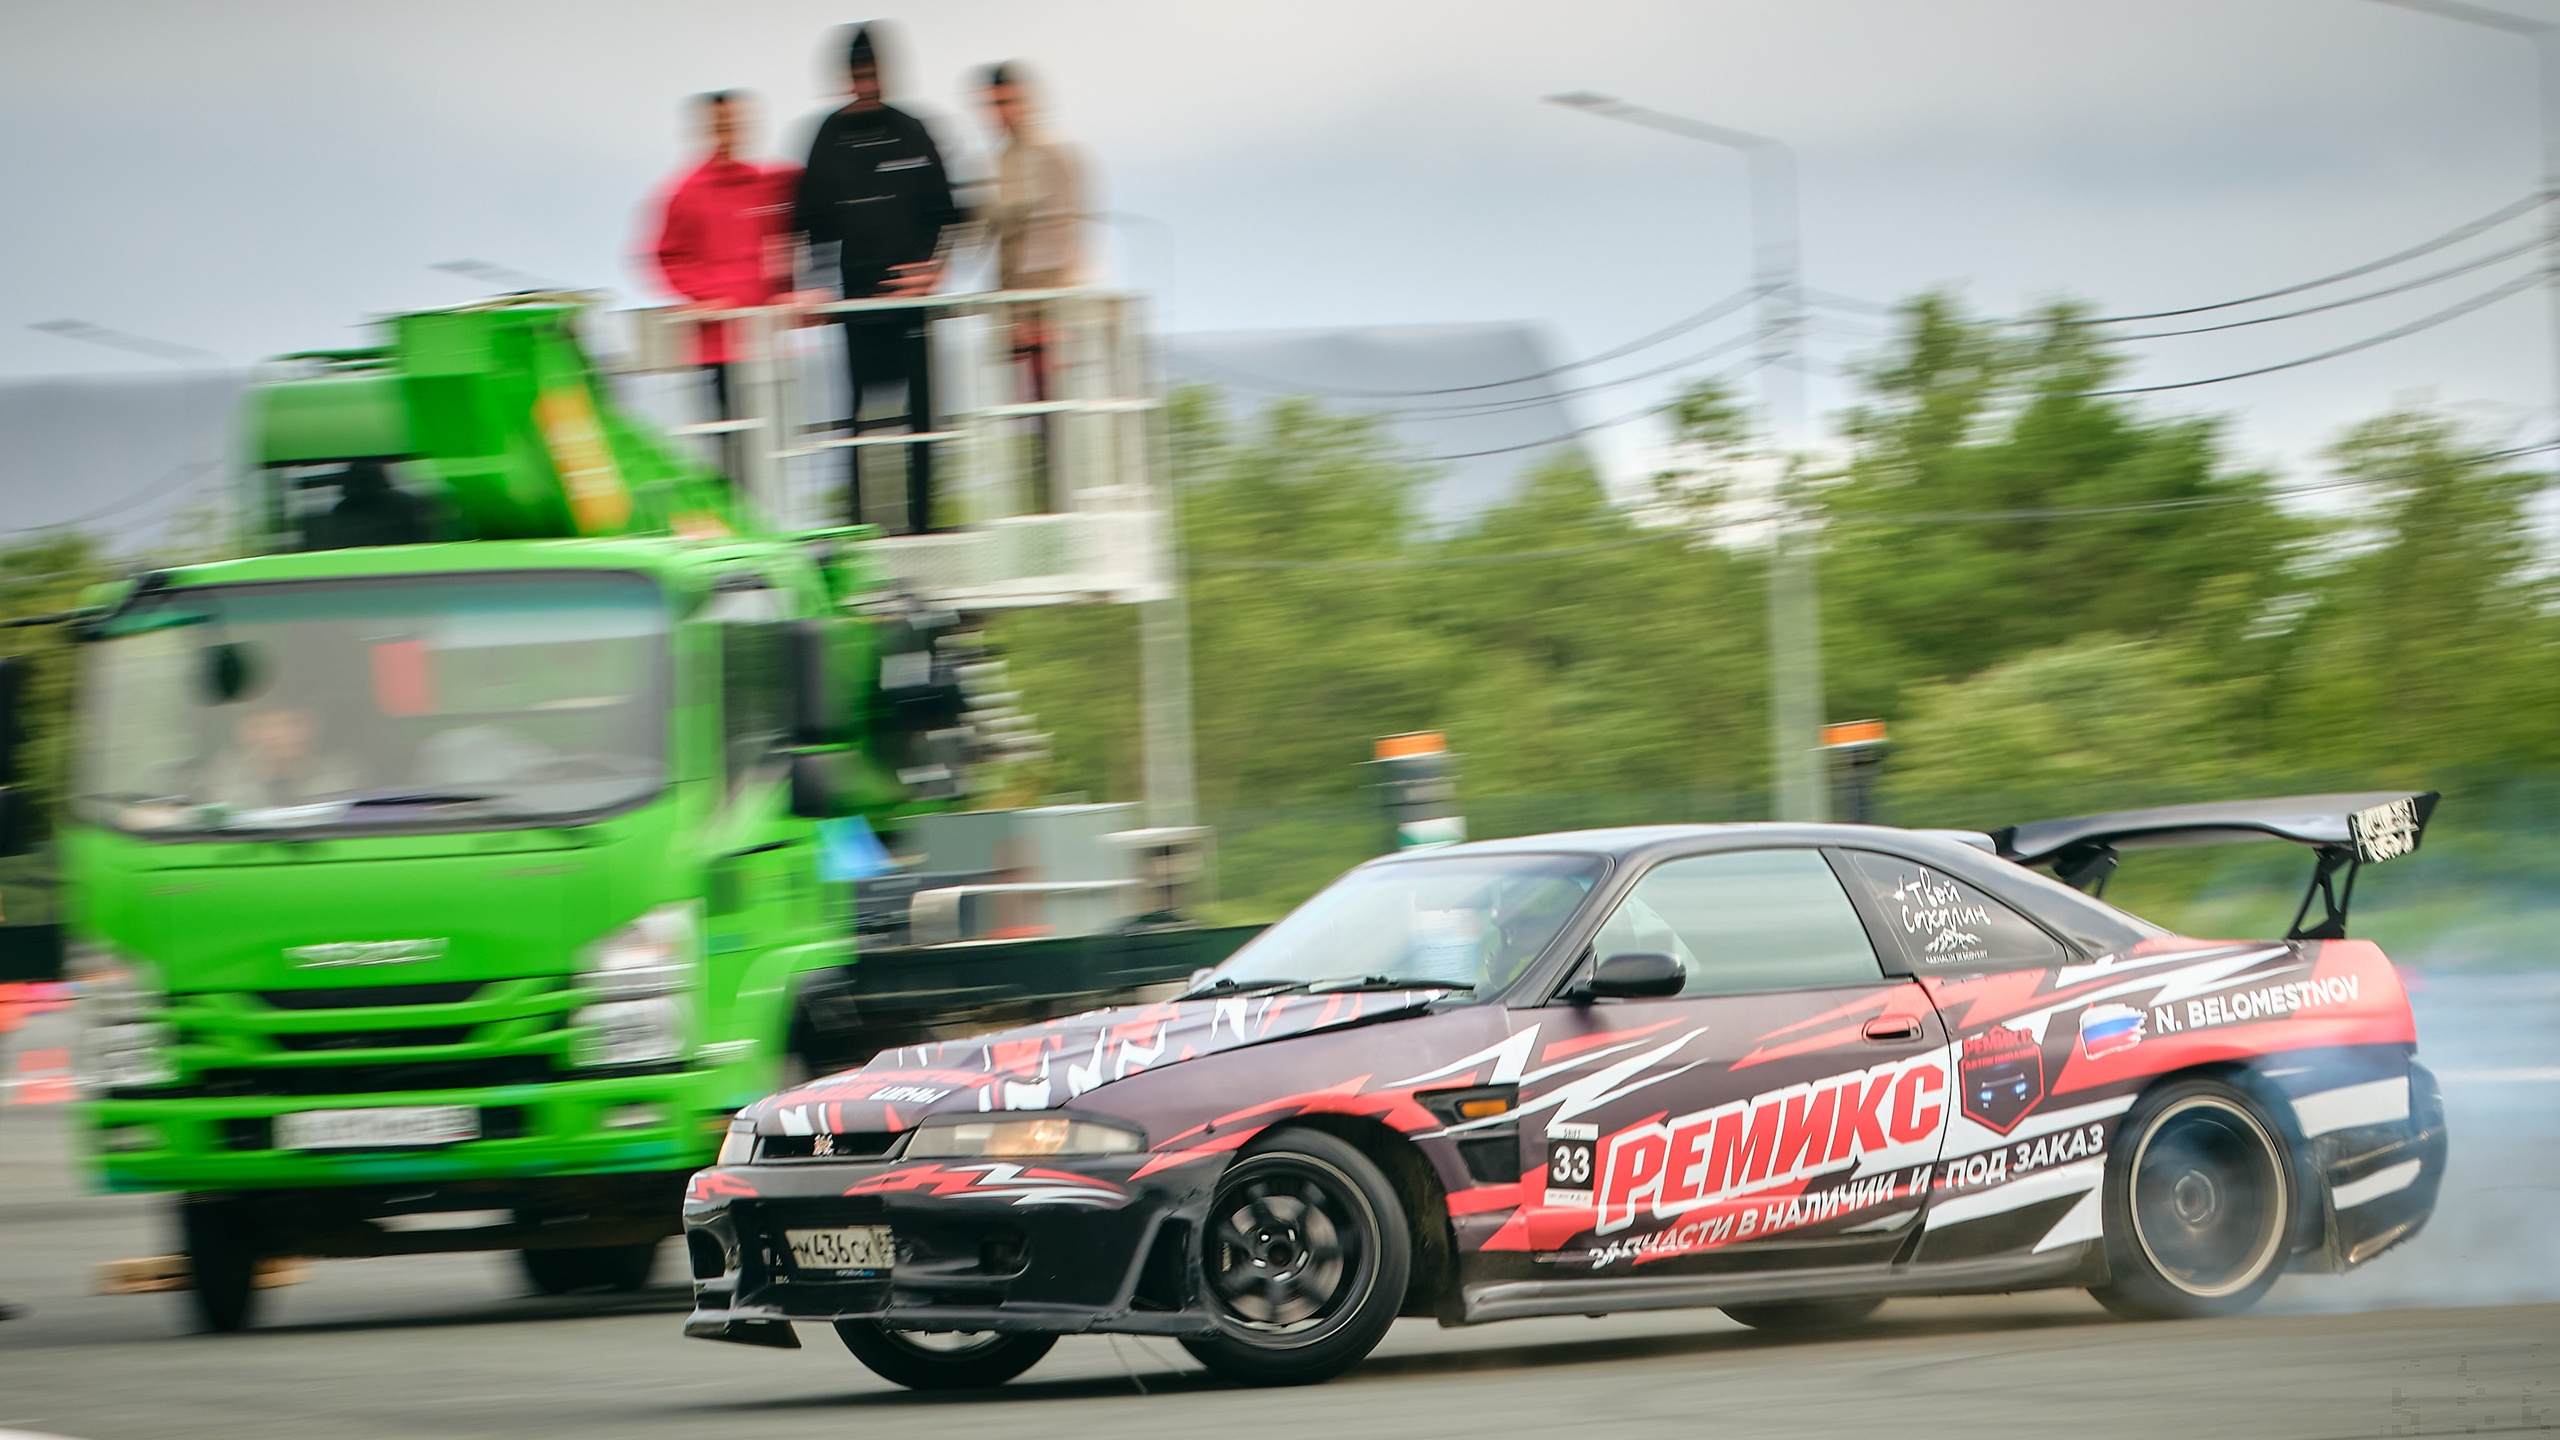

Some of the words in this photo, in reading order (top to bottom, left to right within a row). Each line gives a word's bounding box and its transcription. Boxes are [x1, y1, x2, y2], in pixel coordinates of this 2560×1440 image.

[1905, 867, 1962, 908] Твой
[1902, 905, 1991, 935] Сахалин
[2154, 1004, 2183, 1034] N.
[2187, 974, 2359, 1028] BELOMESTNOV
[1963, 1028, 2033, 1059] РЕМИКС
[1553, 1146, 1590, 1183] 33
[1598, 1062, 1946, 1231] РЕМИКС
[1588, 1214, 1734, 1270] ЗАПЧАСТИ
[1735, 1209, 1758, 1237] В
[1762, 1172, 1898, 1233] НАЛИЧИИ
[1909, 1165, 1933, 1196] И
[1945, 1147, 2008, 1188] ПОД
[2013, 1123, 2105, 1173] ЗАКАЗ
